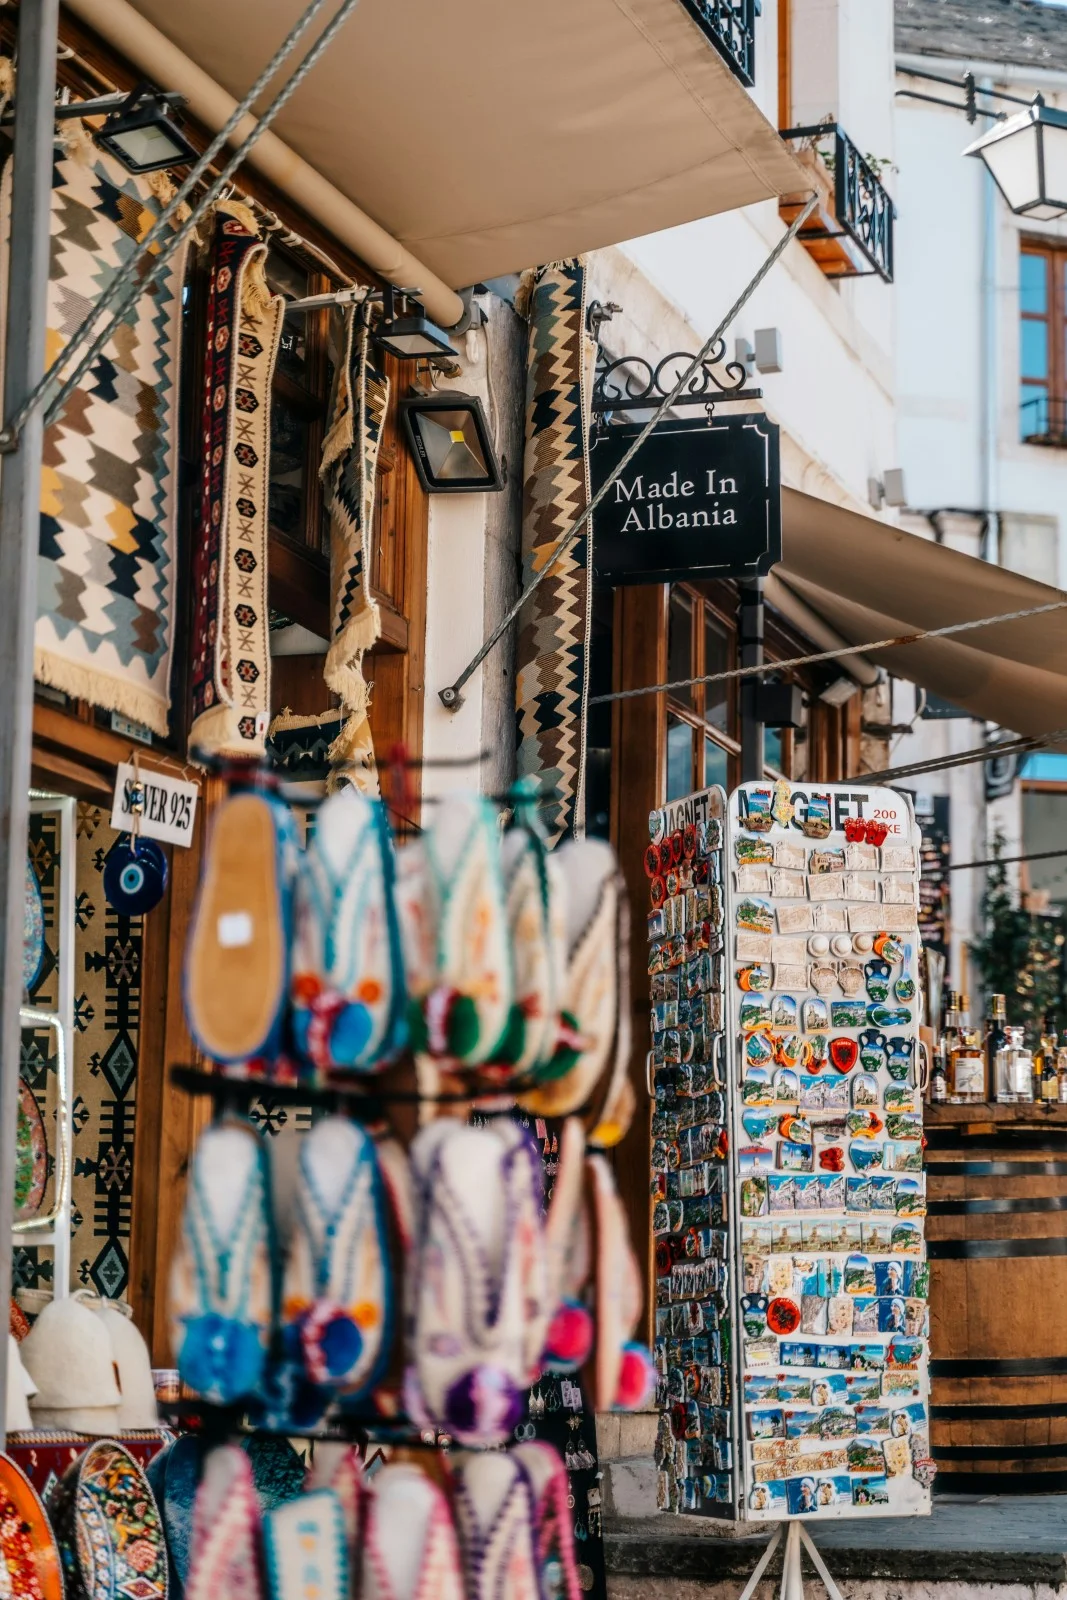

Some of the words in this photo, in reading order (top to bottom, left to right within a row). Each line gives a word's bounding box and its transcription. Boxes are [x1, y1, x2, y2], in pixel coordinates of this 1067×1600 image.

[614, 470, 695, 503] Made
[705, 469, 739, 495] In
[620, 501, 738, 533] Albania
[121, 778, 168, 824] SVER
[169, 791, 192, 830] 925
[873, 809, 897, 820] 200
